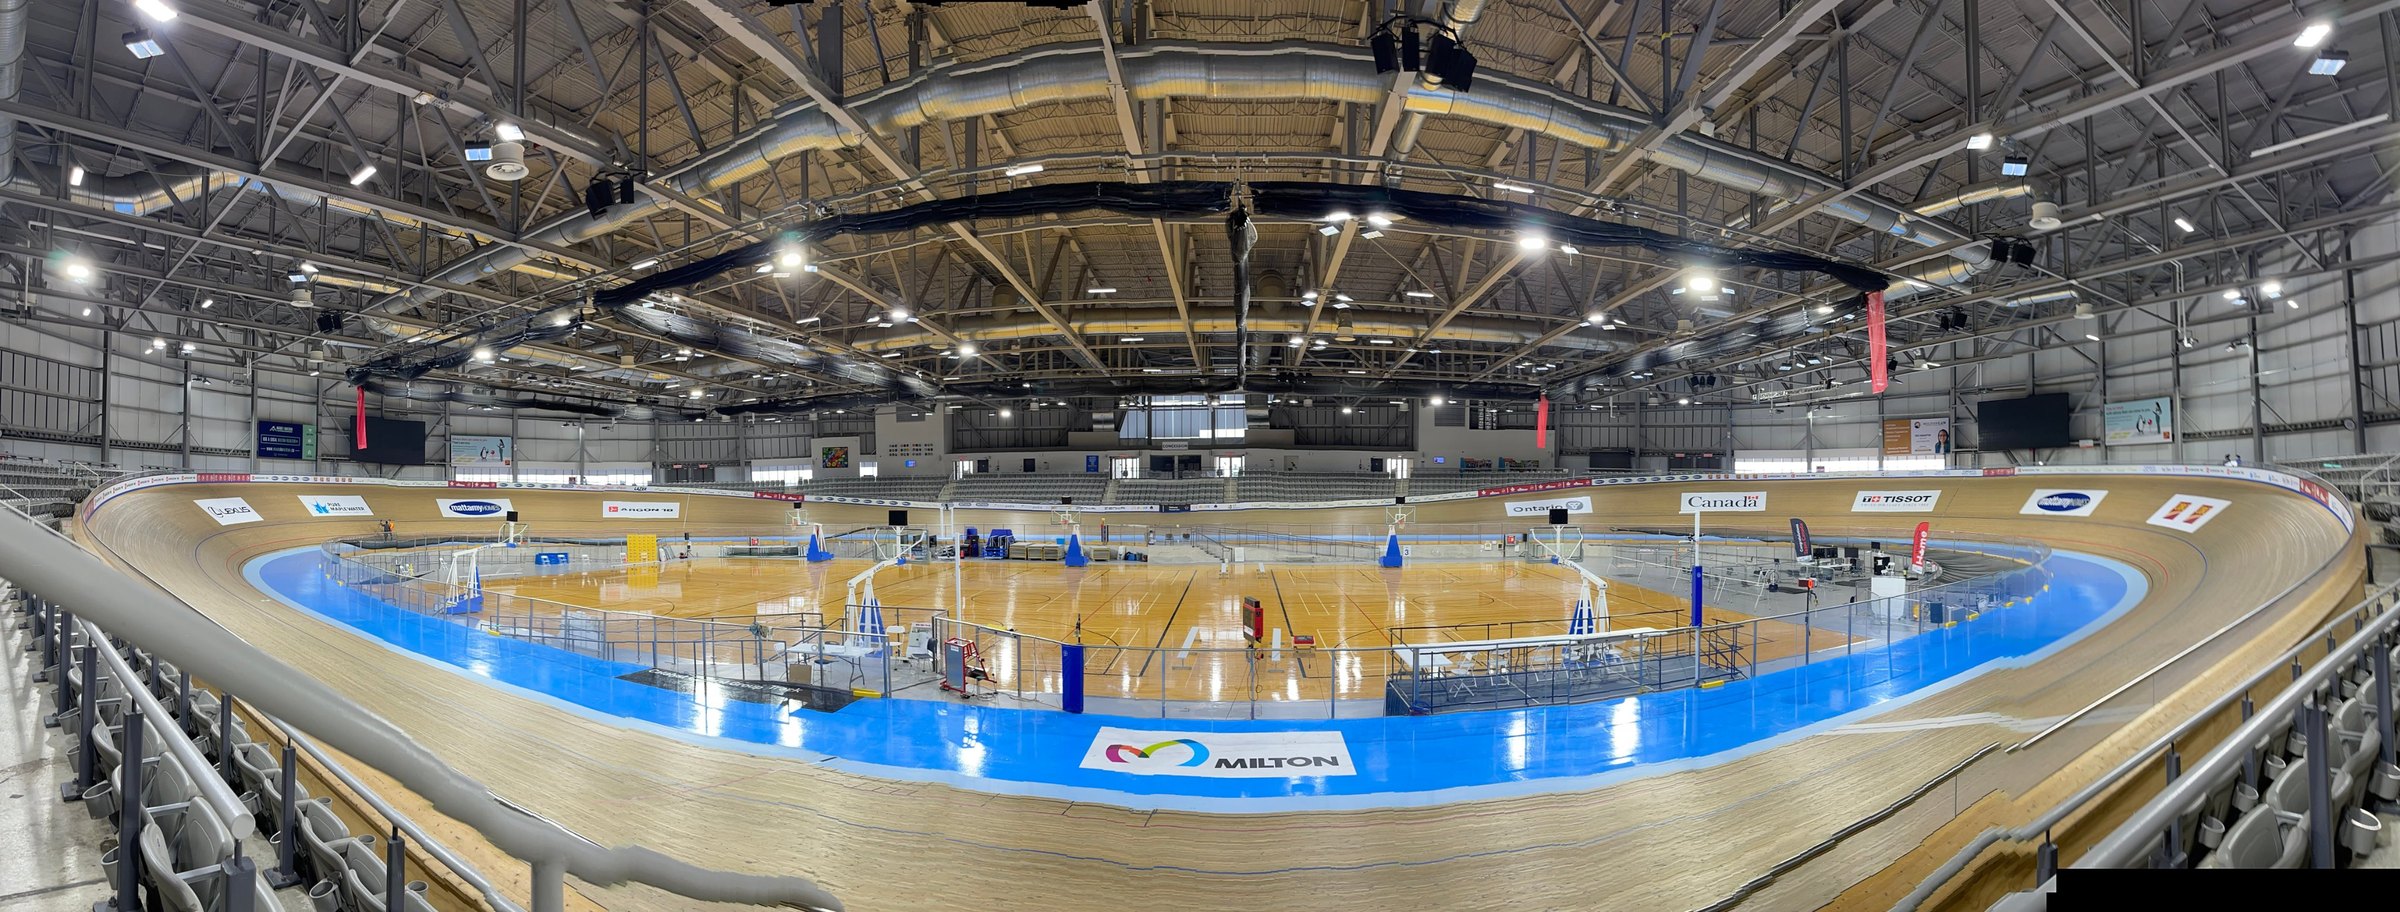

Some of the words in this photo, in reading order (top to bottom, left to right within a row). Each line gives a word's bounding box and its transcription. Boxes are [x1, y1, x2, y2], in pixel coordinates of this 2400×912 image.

[1688, 495, 1757, 508] Canada
[1884, 495, 1932, 503] TISSOT
[1513, 504, 1563, 513] Ontario
[1214, 755, 1339, 769] MILTON
